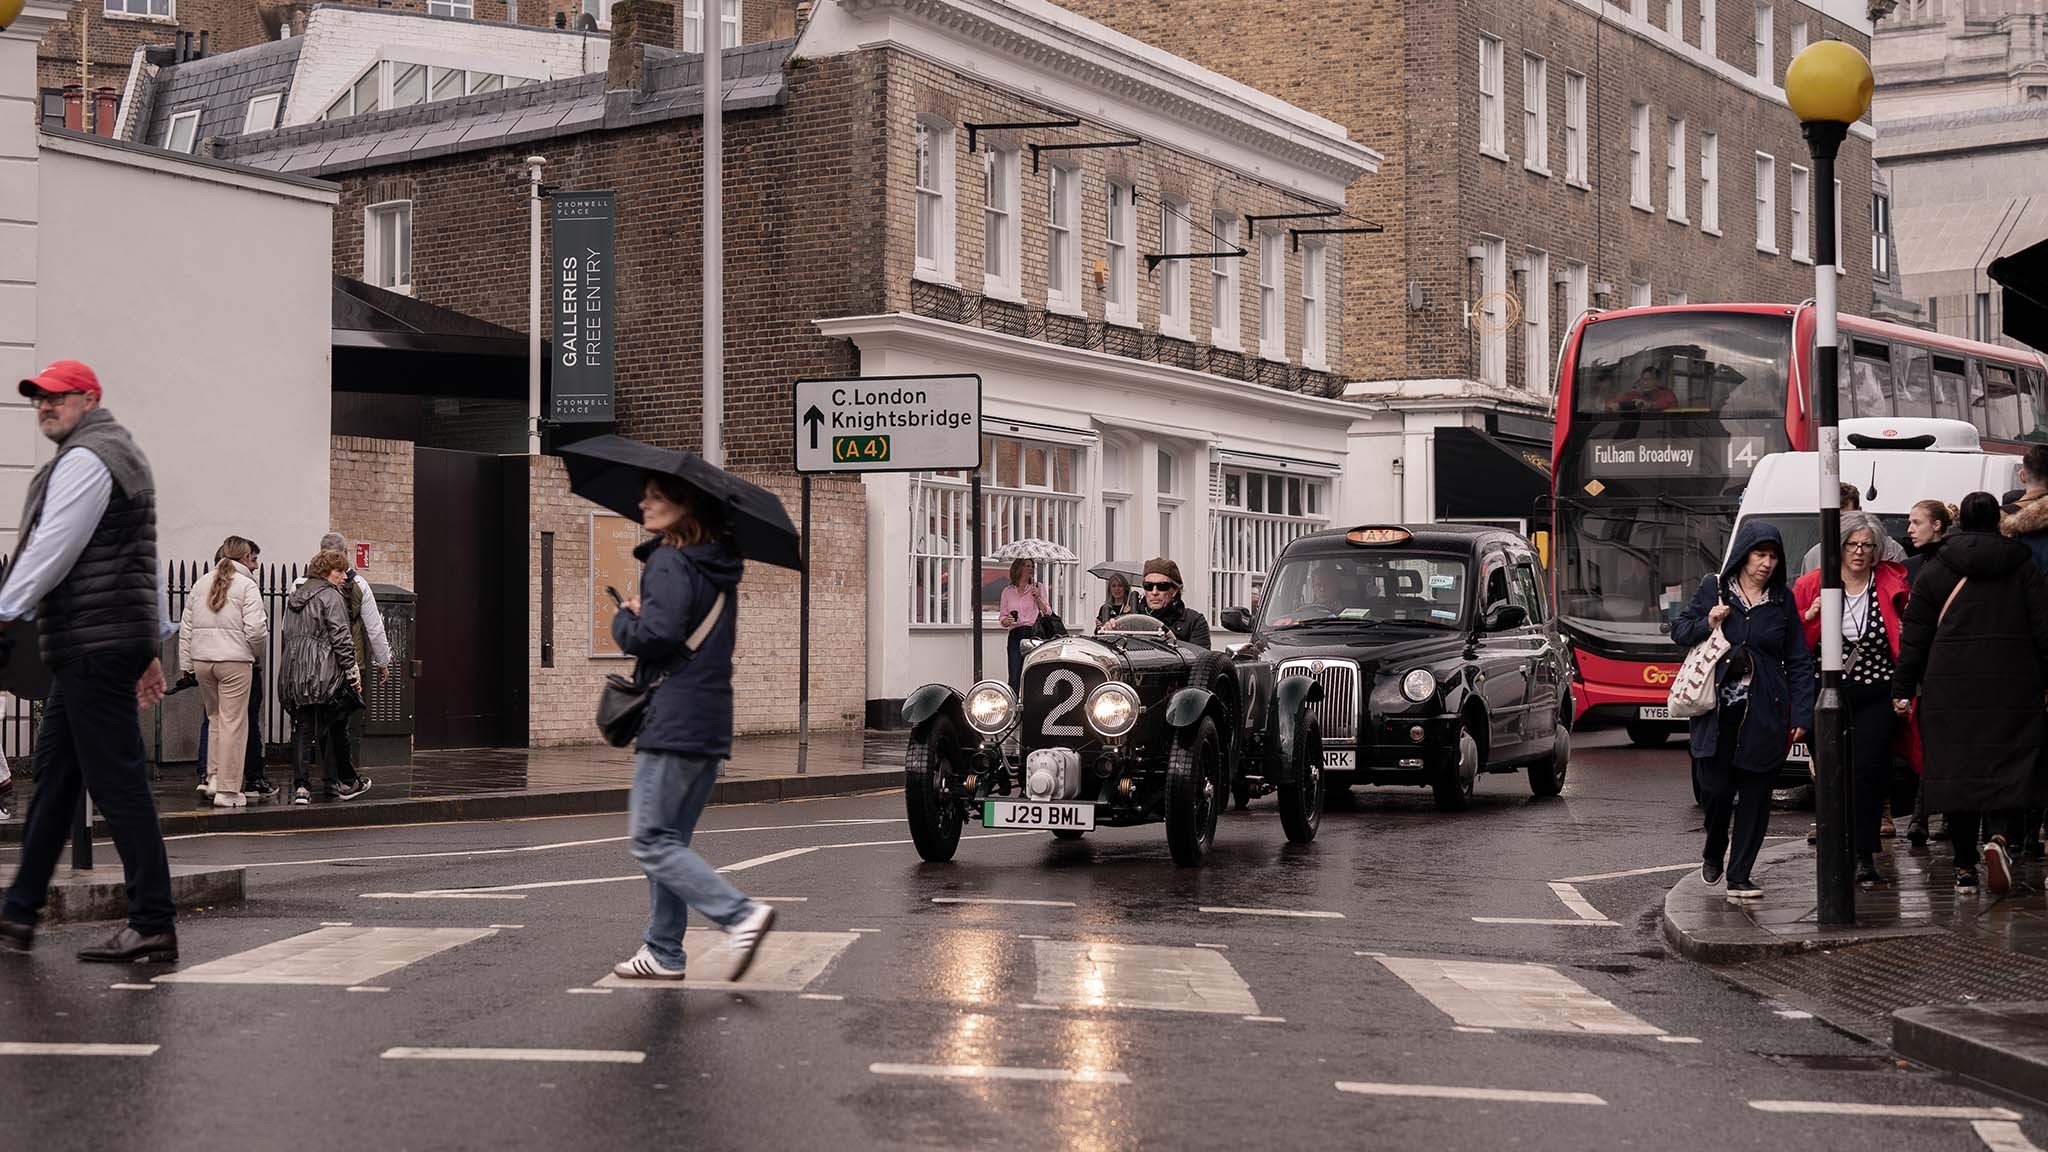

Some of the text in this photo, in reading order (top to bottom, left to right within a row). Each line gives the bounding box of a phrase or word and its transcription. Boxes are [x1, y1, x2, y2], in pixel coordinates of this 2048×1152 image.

[562, 256, 577, 367] GALLERIES
[586, 247, 601, 366] FREE ENTRY
[832, 388, 927, 406] C.London
[832, 409, 972, 431] Knightsbridge
[835, 436, 888, 460] (A4)
[1594, 444, 1694, 467] Fulham Broadway
[1727, 440, 1759, 469] 14
[1360, 530, 1396, 541] TAXI
[1643, 665, 1669, 684] Go
[1041, 669, 1086, 737] 2
[1245, 673, 1257, 729] 2
[1644, 709, 1669, 718] YY66
[1005, 805, 1086, 826] J29 BML
